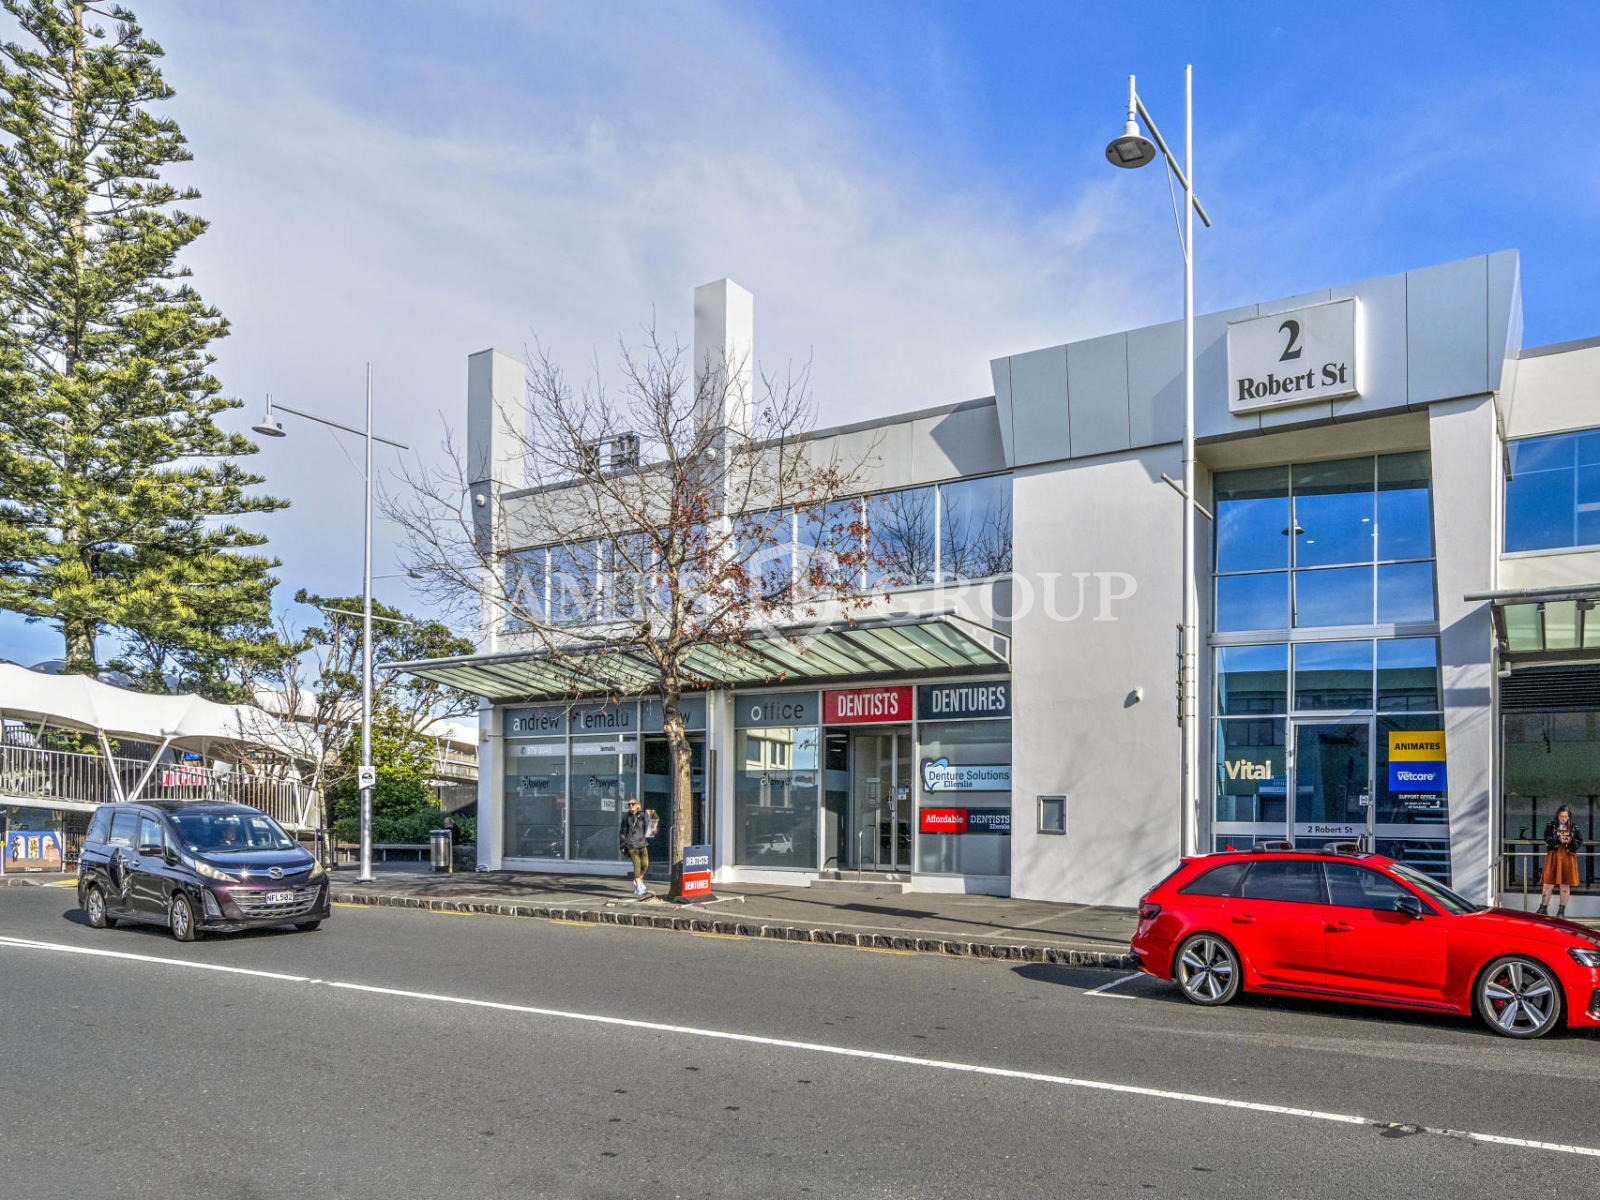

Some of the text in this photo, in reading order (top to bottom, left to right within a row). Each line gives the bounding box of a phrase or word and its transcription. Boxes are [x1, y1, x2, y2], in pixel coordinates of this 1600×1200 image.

[1278, 319, 1303, 362] 2
[1237, 362, 1348, 401] Robert St
[837, 692, 899, 717] DENTISTS
[932, 686, 1006, 713] DENTURES
[513, 708, 629, 732] andrew lemalu
[751, 703, 804, 721] office
[1394, 742, 1441, 751] ANIMATES
[928, 770, 1010, 781] Denture Solutions
[925, 814, 1010, 824] Affordable DENTISTS
[1308, 825, 1352, 834] 2 Robert St
